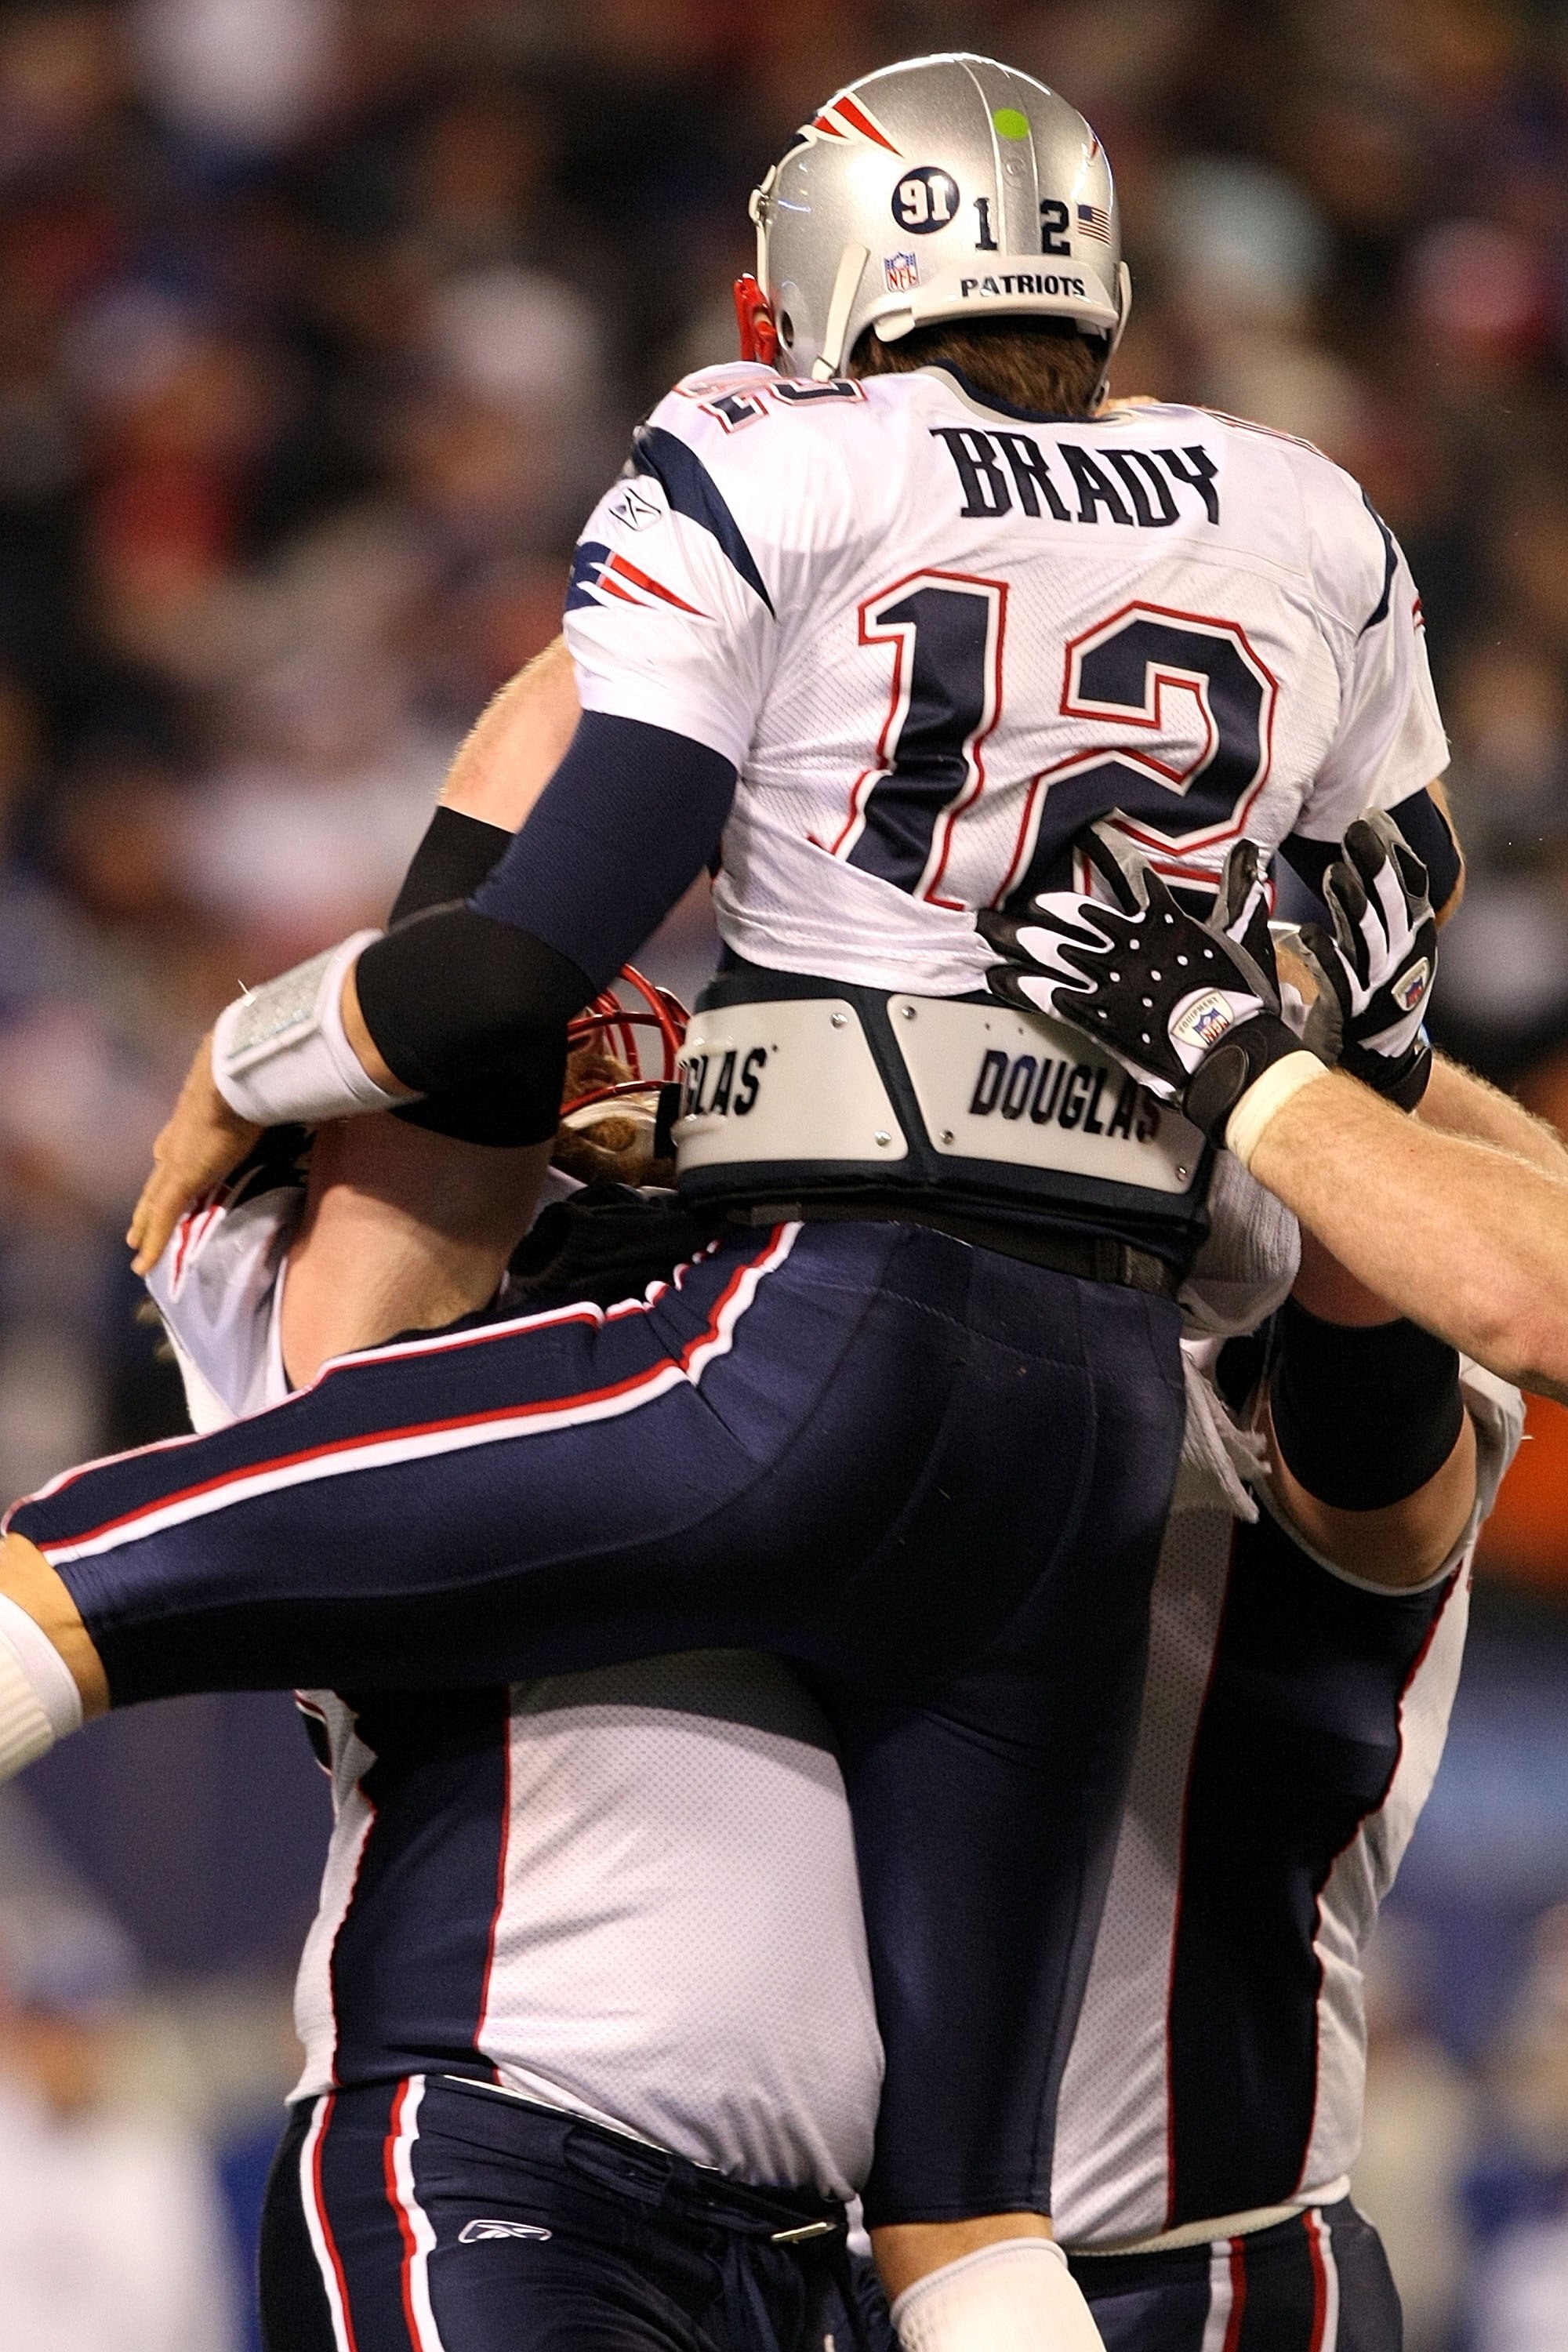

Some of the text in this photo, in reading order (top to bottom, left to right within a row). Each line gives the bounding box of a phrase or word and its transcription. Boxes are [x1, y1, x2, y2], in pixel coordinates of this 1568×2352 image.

[898, 175, 951, 225] 91
[886, 263, 917, 292] NFL
[960, 274, 1086, 297] PATRIOTS
[930, 427, 1220, 528] BRADY
[806, 568, 1279, 919] 12
[1178, 996, 1219, 1034] EQUIPMENT
[968, 1048, 1161, 1144] DOUGLAS
